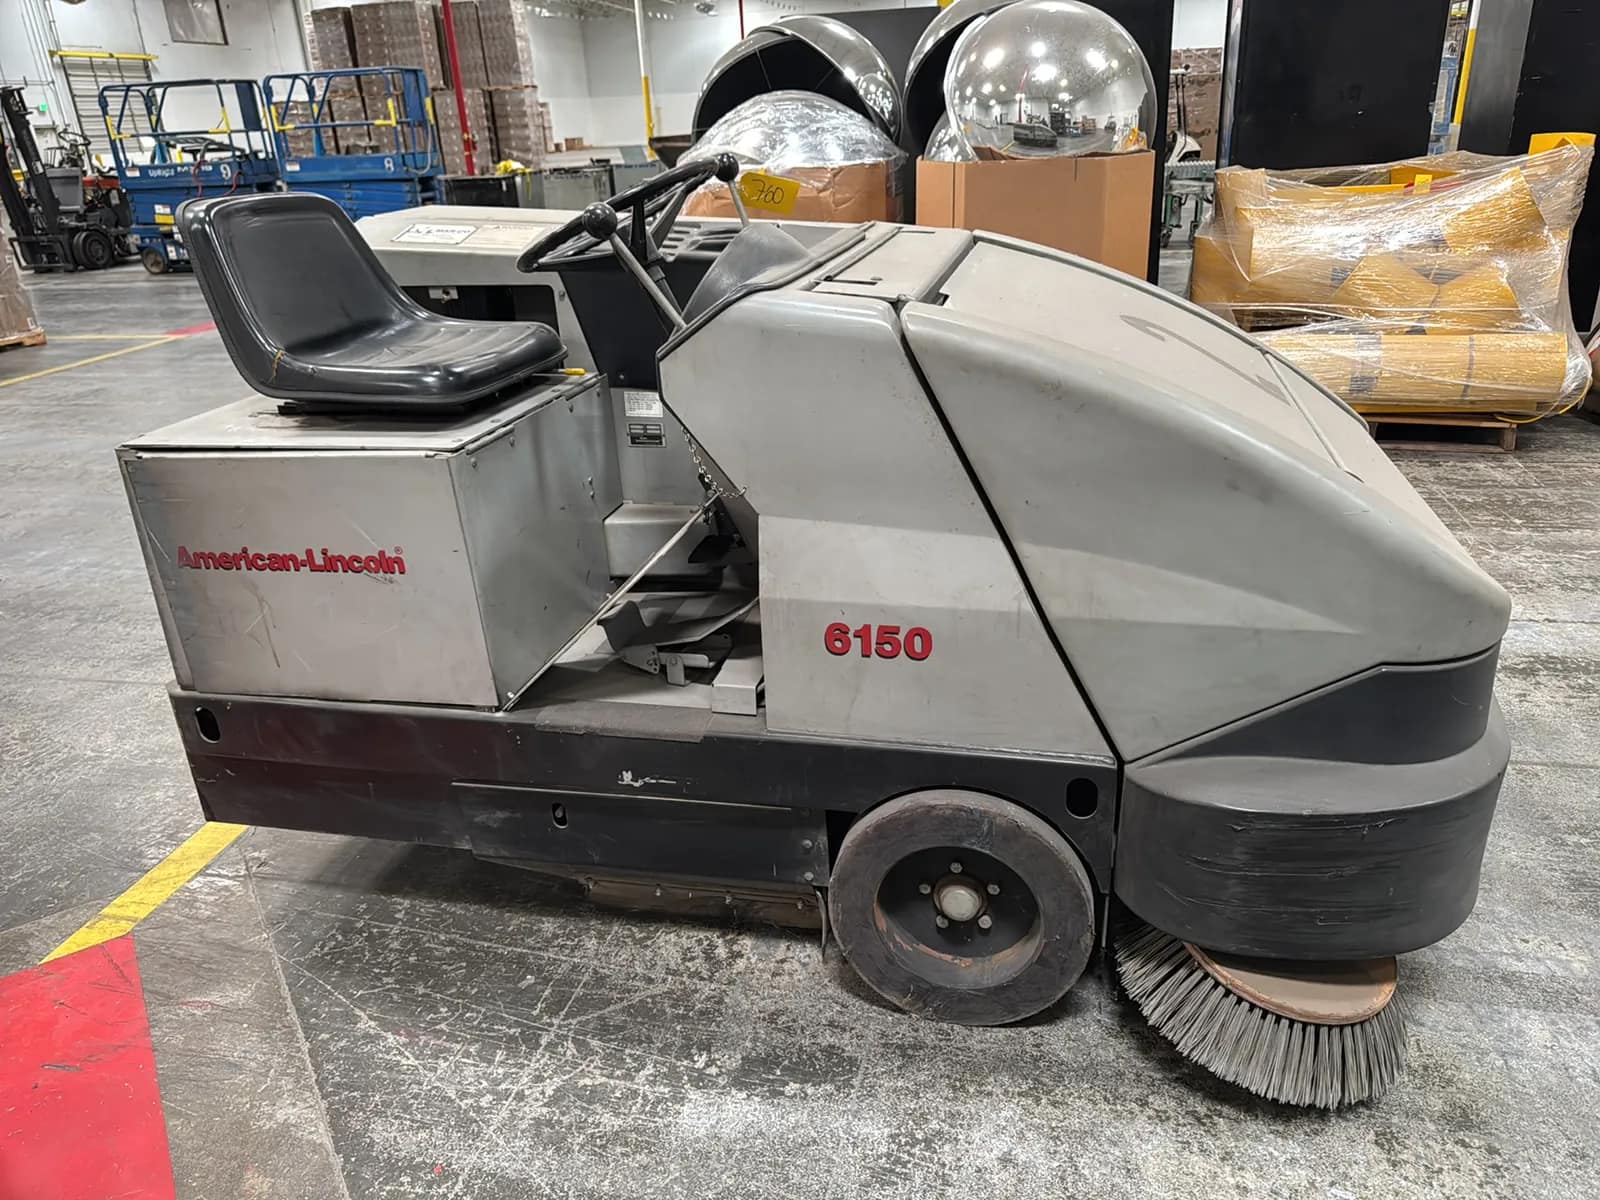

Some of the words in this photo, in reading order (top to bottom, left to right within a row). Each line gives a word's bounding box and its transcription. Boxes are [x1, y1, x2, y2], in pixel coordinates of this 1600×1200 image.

[220, 163, 232, 180] 9
[383, 157, 395, 172] 8
[751, 178, 785, 205] 760
[824, 622, 933, 661] 6150
